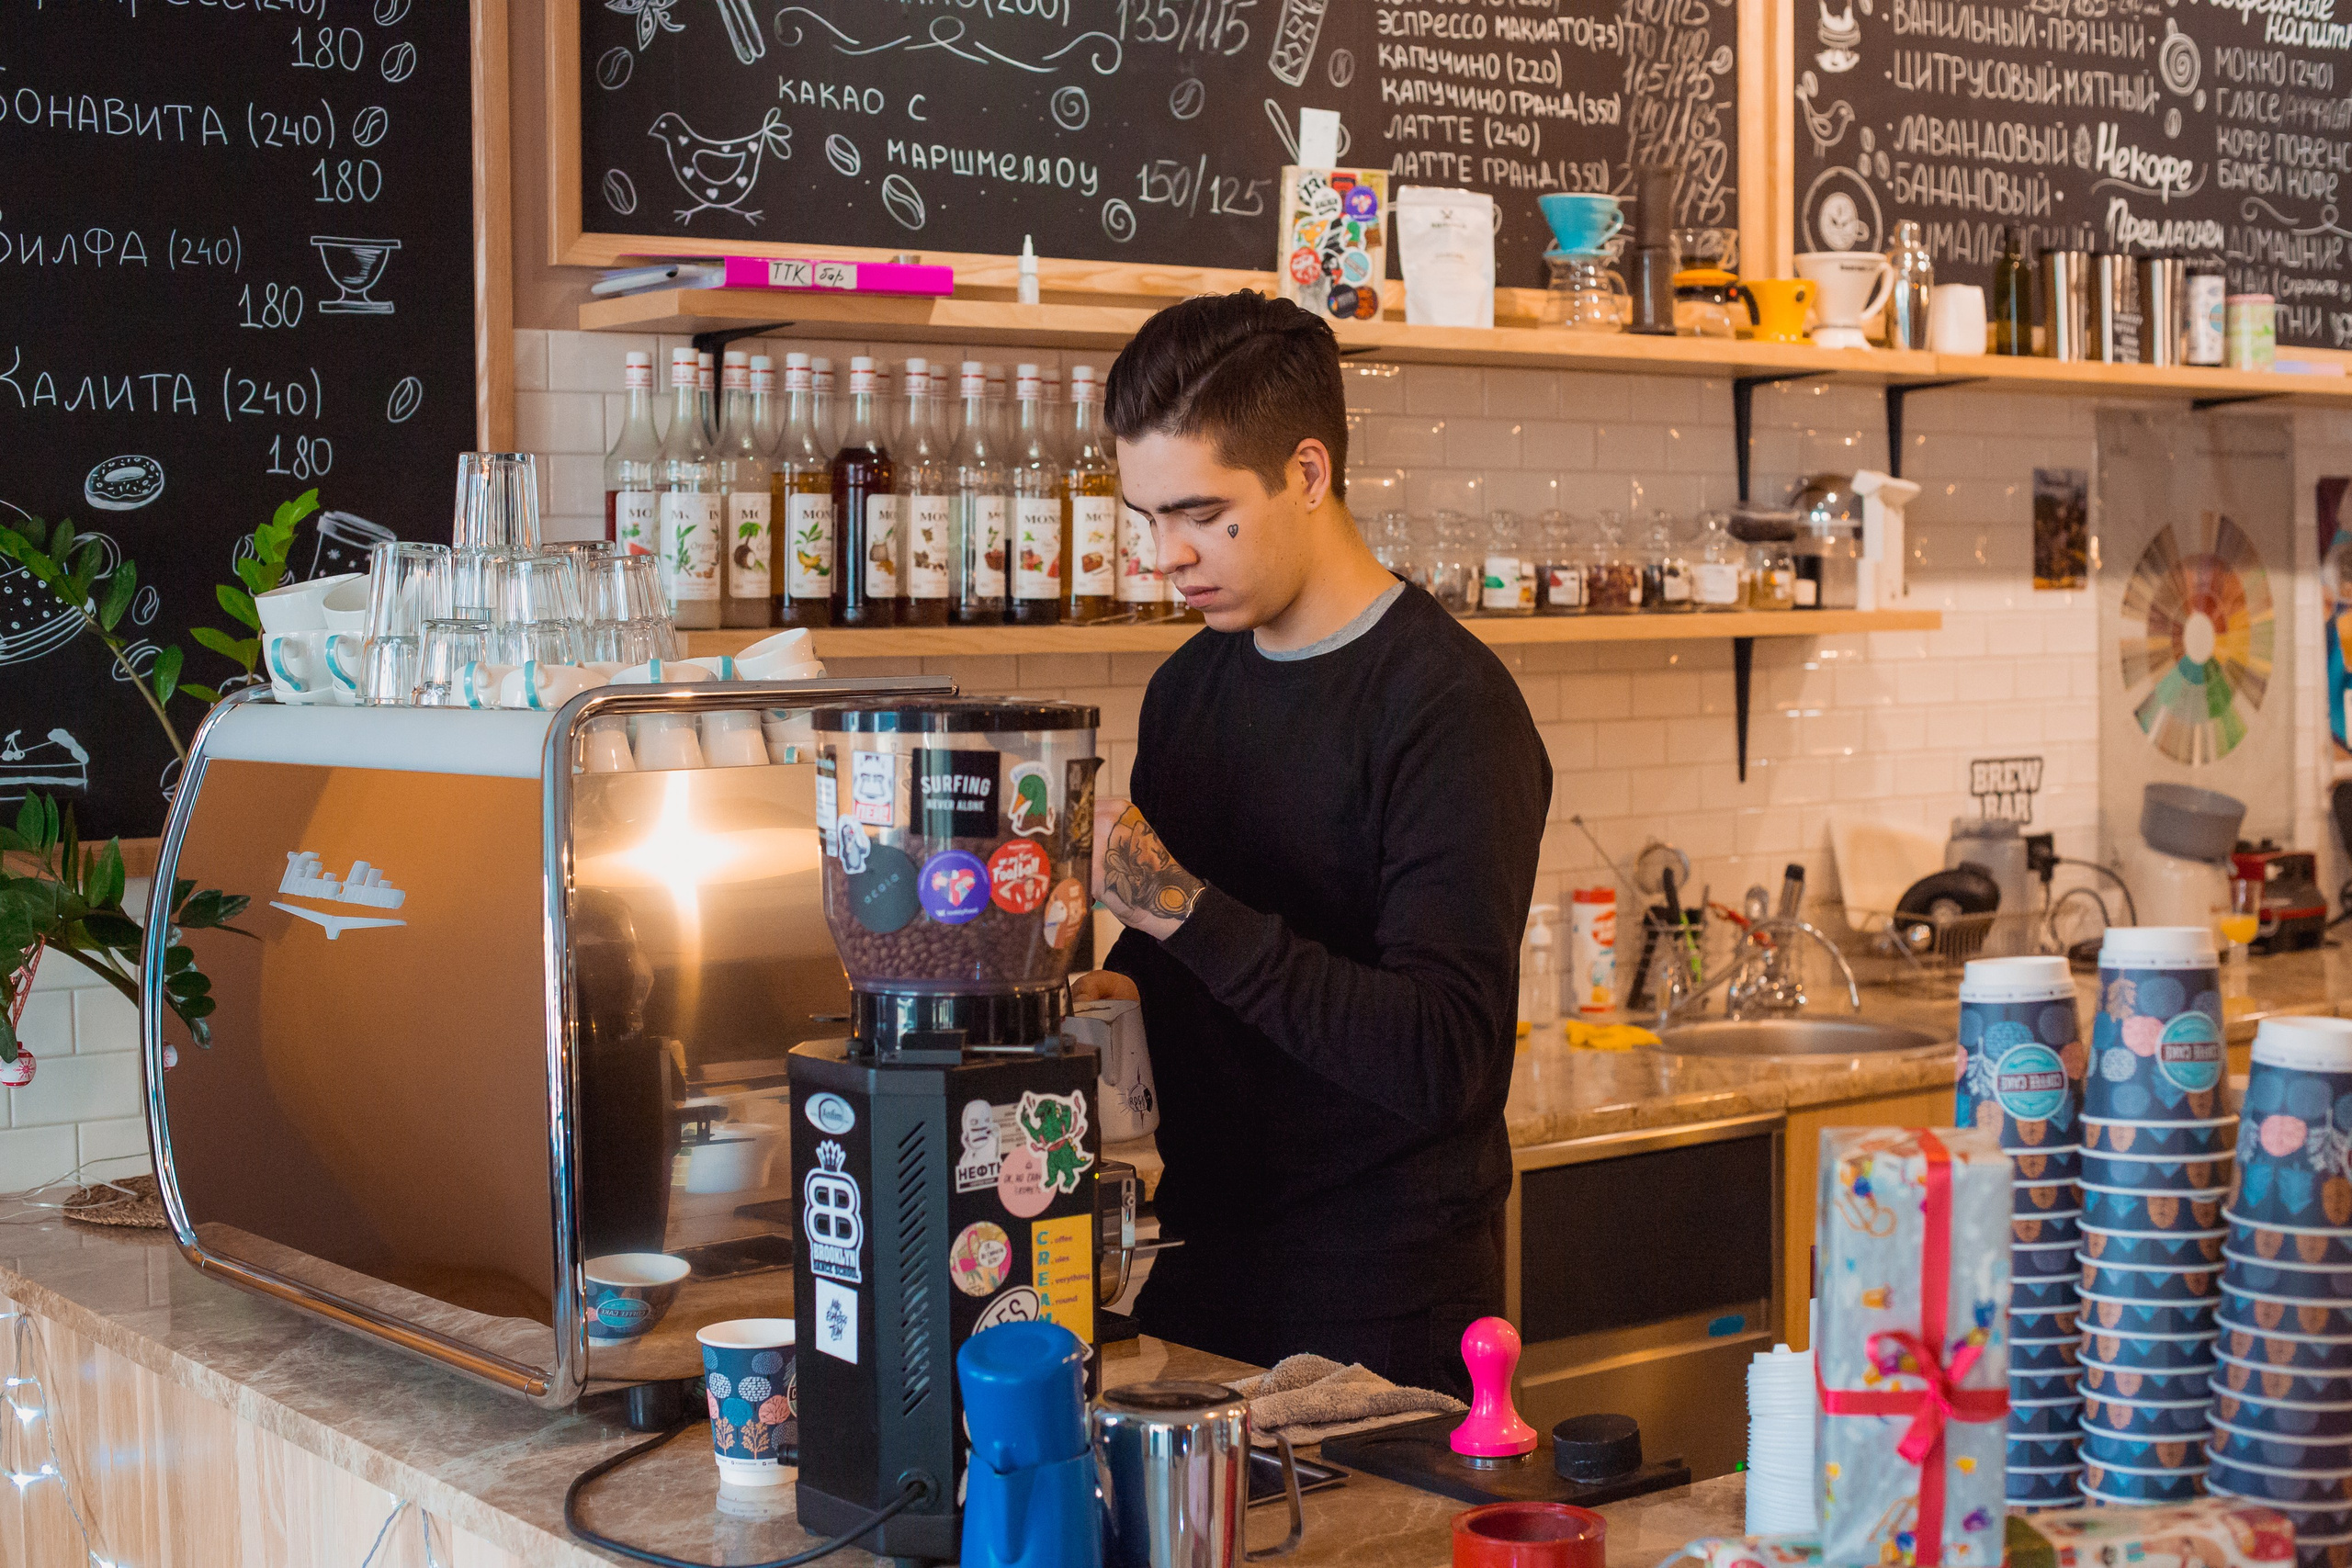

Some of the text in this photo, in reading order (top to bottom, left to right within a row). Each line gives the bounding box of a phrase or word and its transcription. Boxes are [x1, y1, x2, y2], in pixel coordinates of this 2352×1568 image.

[291, 27, 364, 71] 180
[1378, 43, 1562, 89] КАПУЧИНО (220)
[778, 75, 885, 115] КАКАО
[1381, 77, 1507, 115] КАПУЧИНО
[1894, 49, 2058, 107] ЦИТРУСОВЫЙ
[0, 89, 334, 149] ОНАВИТА (240)
[1384, 114, 1541, 157] ЛАТТЕ (240)
[1894, 114, 2067, 166] ЛАВАНДОВЫЙ
[312, 159, 382, 202] 180
[1137, 153, 1272, 219] 150/125
[1388, 151, 1473, 183] ЛАТТЕ
[1894, 162, 2051, 218] БАНАНОВЫЙ
[169, 226, 242, 274] (240)
[239, 283, 303, 328] 180
[224, 367, 322, 422] (240)
[266, 434, 333, 480] 180
[921, 774, 991, 797] SURFING
[1973, 759, 2041, 795] BREW
[956, 800, 985, 812] ALONE
[813, 1242, 856, 1268] BROOKLYN
